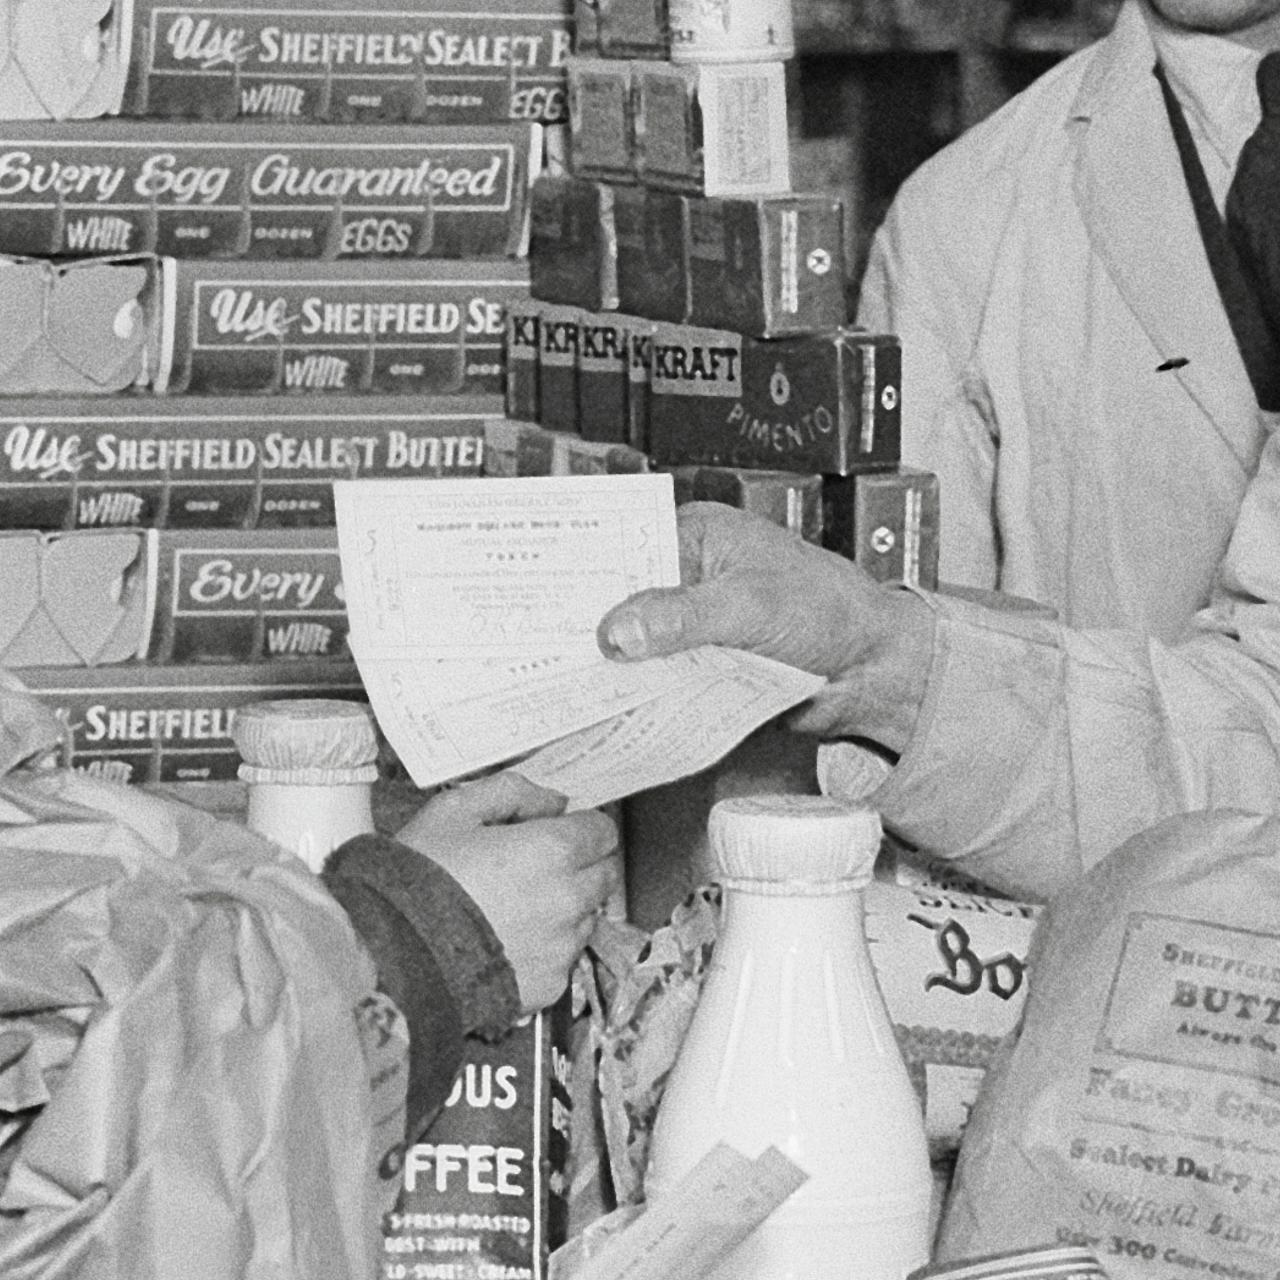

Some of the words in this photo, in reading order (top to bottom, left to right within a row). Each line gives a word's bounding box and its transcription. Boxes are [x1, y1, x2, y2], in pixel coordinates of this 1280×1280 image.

[167, 15, 258, 68] Use
[261, 24, 419, 65] SHEFFIELD
[425, 26, 543, 67] SEALECT
[240, 84, 305, 116] WHITE
[425, 93, 483, 108] DOZEN
[509, 87, 567, 120] EGG
[134, 153, 230, 201] Egg
[250, 153, 502, 198] Guaranteed
[66, 218, 133, 251] WHITE
[253, 226, 313, 240] DOZEN
[340, 219, 412, 253] EGGS
[209, 288, 301, 342] Use
[301, 297, 460, 335] SHEFFIELD
[284, 355, 350, 389] WHITE
[466, 363, 502, 376] DOZ
[654, 344, 739, 382] KRAFT
[726, 402, 834, 452] PIMENTO
[3, 424, 94, 478] Use
[95, 433, 256, 472] SHEFFIELD
[260, 431, 379, 470] SEALECT
[79, 492, 144, 525] WHITE
[189, 558, 325, 608] Every
[268, 622, 333, 656] WHITE
[1084, 1067, 1193, 1116] Fancy
[404, 1143, 525, 1196] FFEE
[1174, 1156, 1253, 1194] Dairy
[1079, 1190, 1199, 1228] Sheffield
[1108, 1234, 1158, 1260] 300
